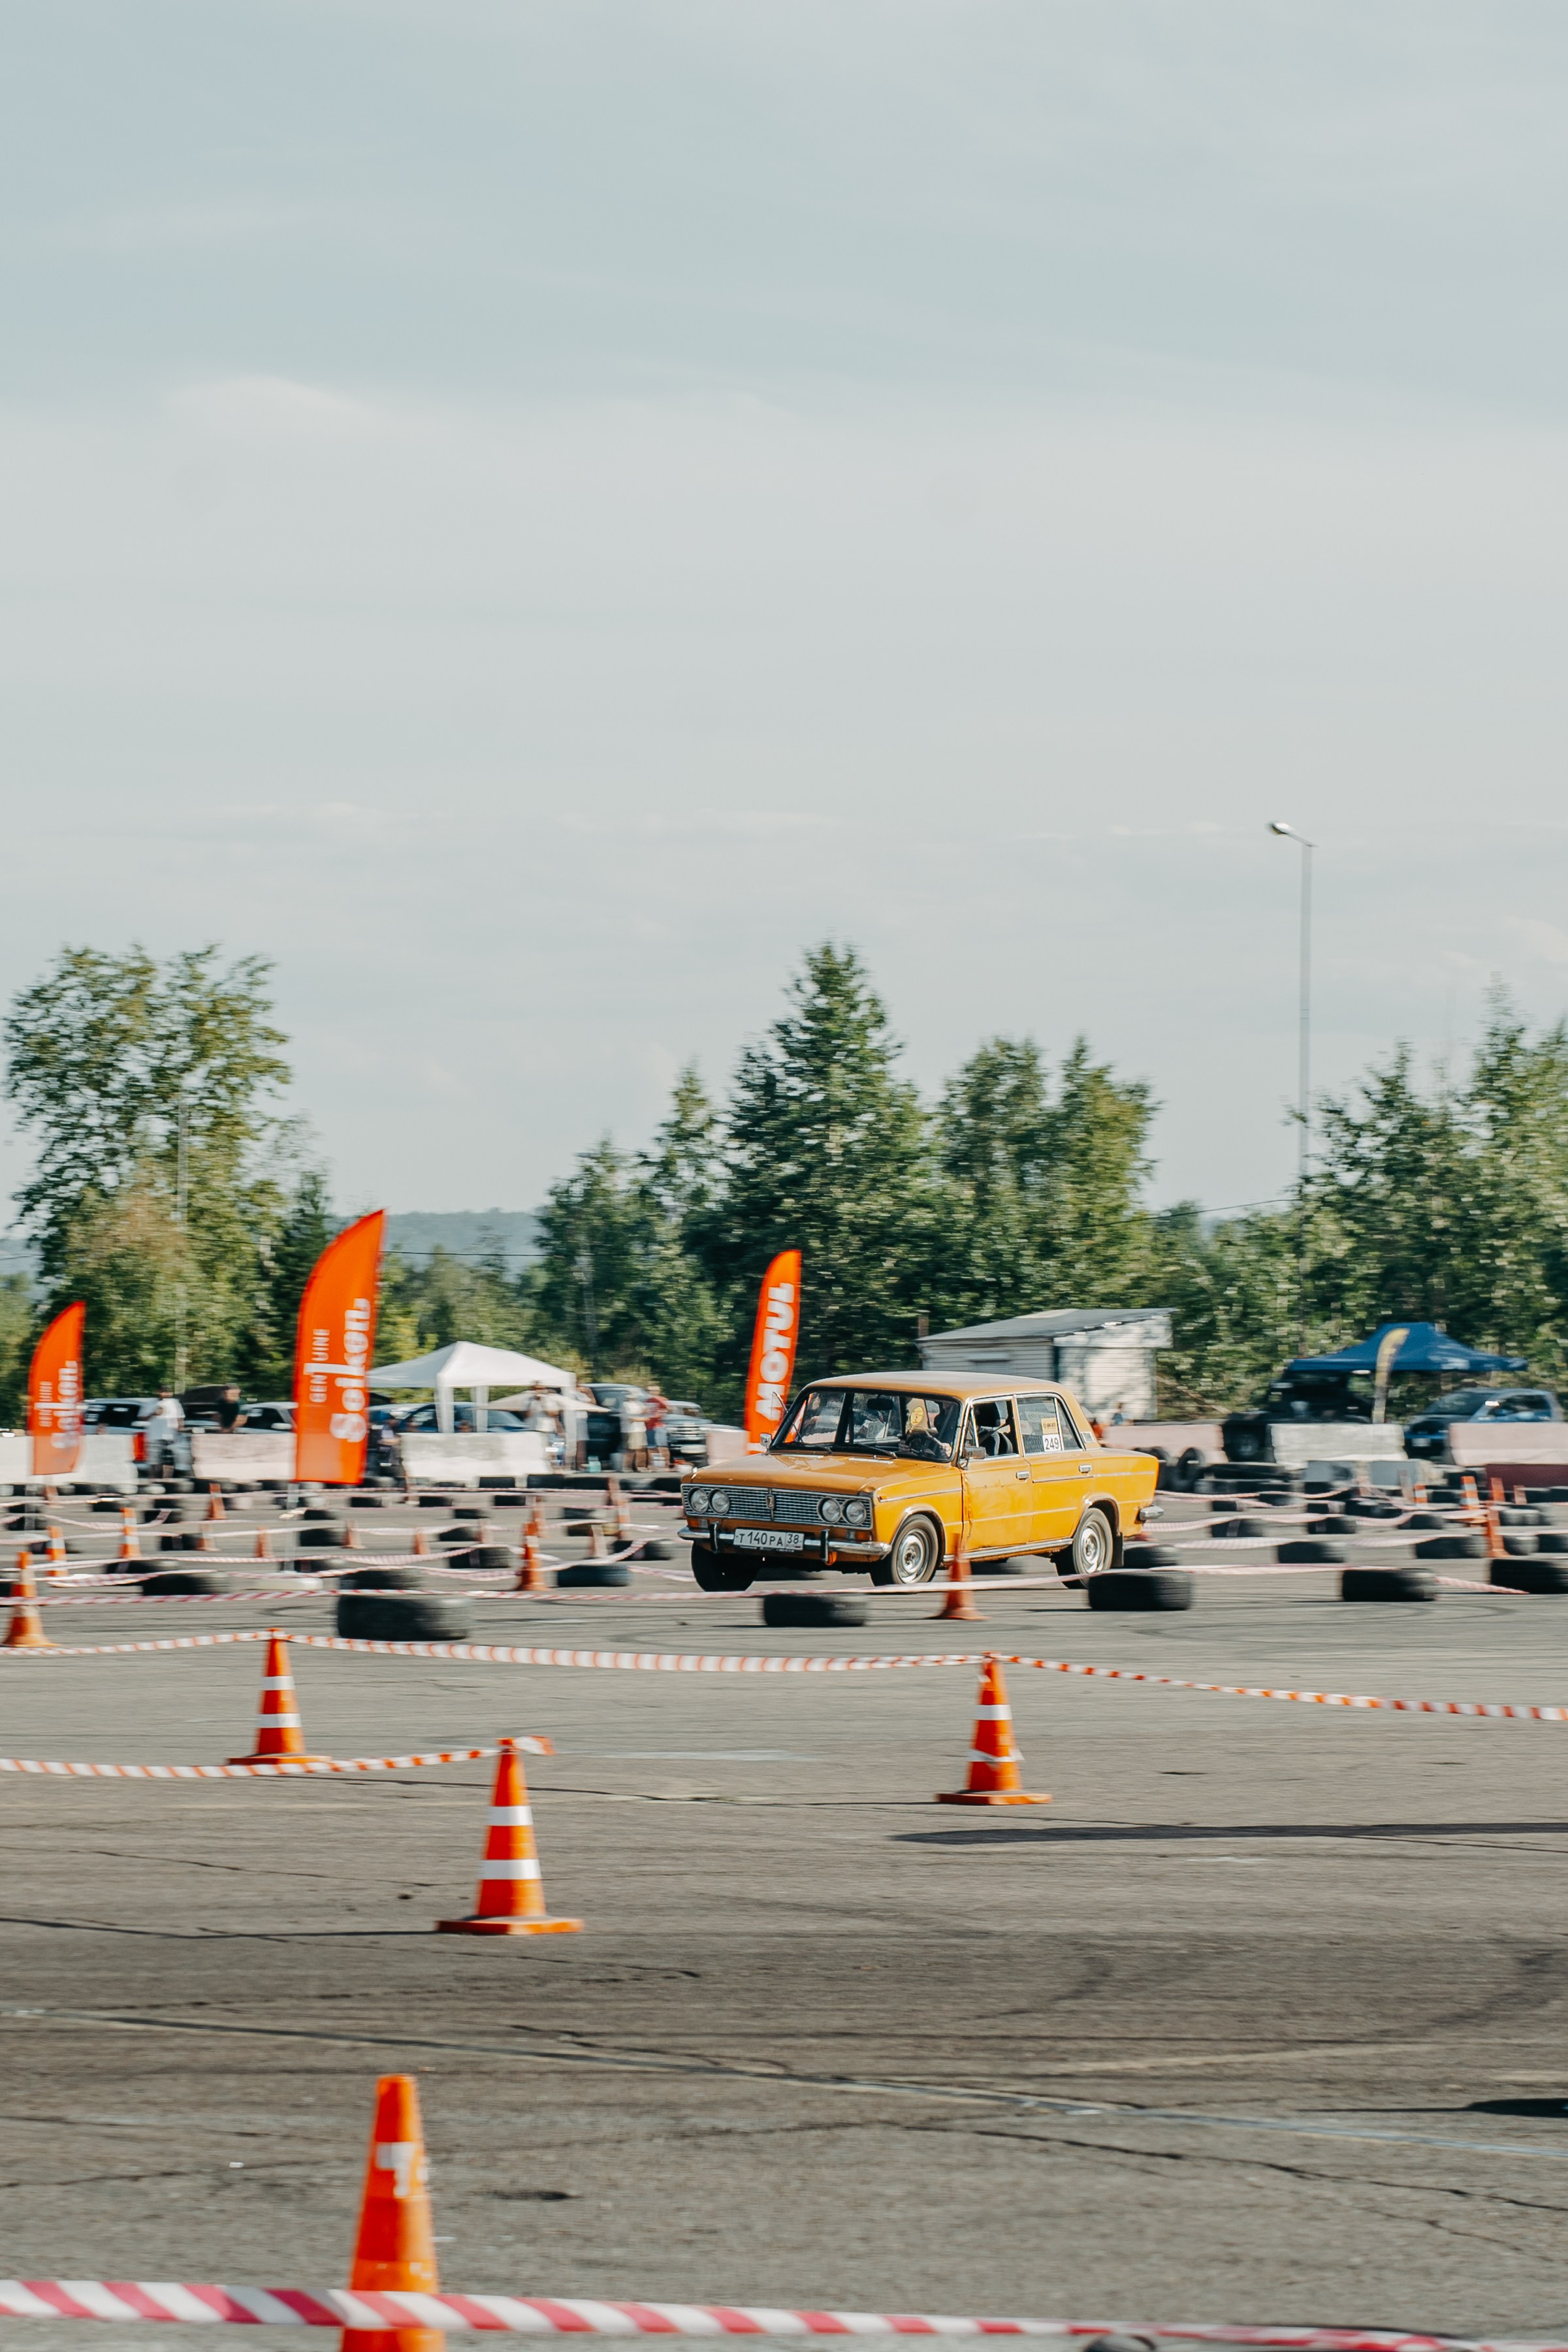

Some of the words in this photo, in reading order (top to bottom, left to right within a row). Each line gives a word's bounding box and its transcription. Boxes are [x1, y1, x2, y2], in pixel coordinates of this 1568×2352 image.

[309, 1329, 330, 1402] GENUINE
[756, 1282, 795, 1421] MOTUL
[1044, 1437, 1059, 1450] 249
[787, 1534, 799, 1544] 38
